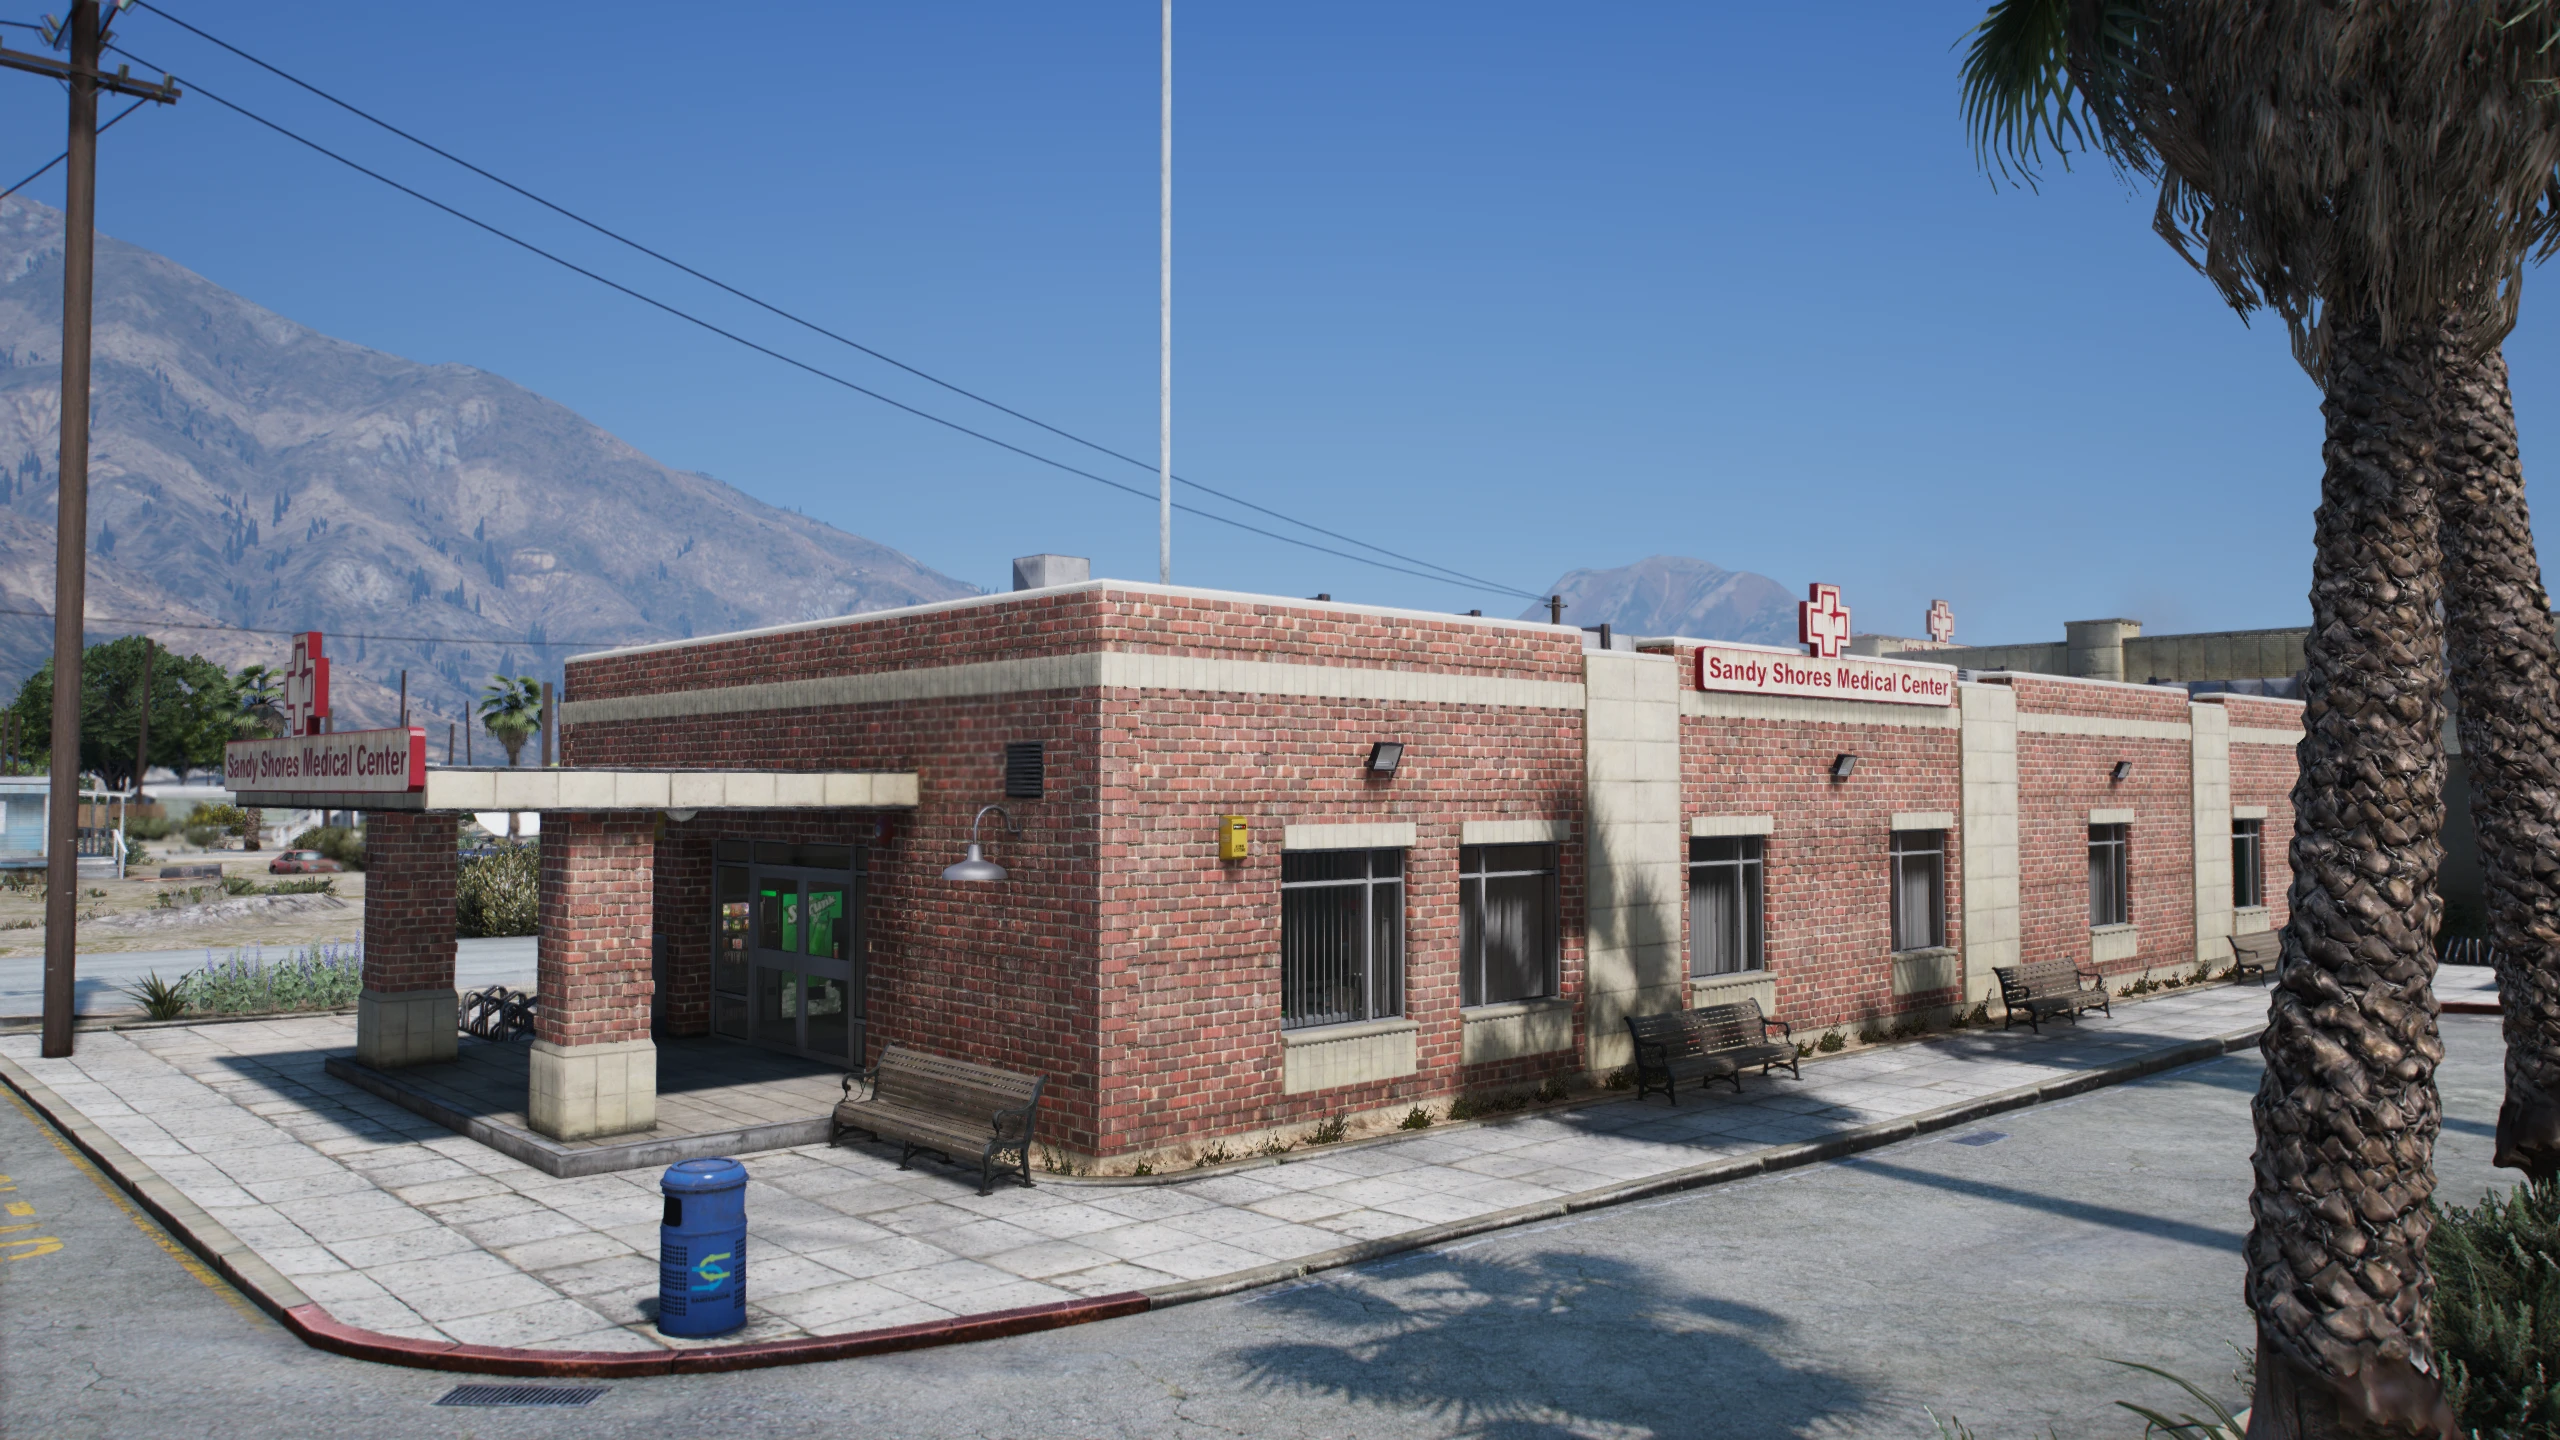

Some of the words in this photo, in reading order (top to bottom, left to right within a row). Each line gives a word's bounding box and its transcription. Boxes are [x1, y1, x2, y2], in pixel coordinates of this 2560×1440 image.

[1709, 657, 1767, 687] Sandy
[1773, 662, 1832, 687] Shores
[1837, 668, 1897, 692] Medical
[1902, 674, 1949, 696] Center
[227, 753, 258, 784] Sandy
[261, 750, 299, 778] Shores
[303, 746, 352, 777] Medical
[357, 744, 407, 776] Center
